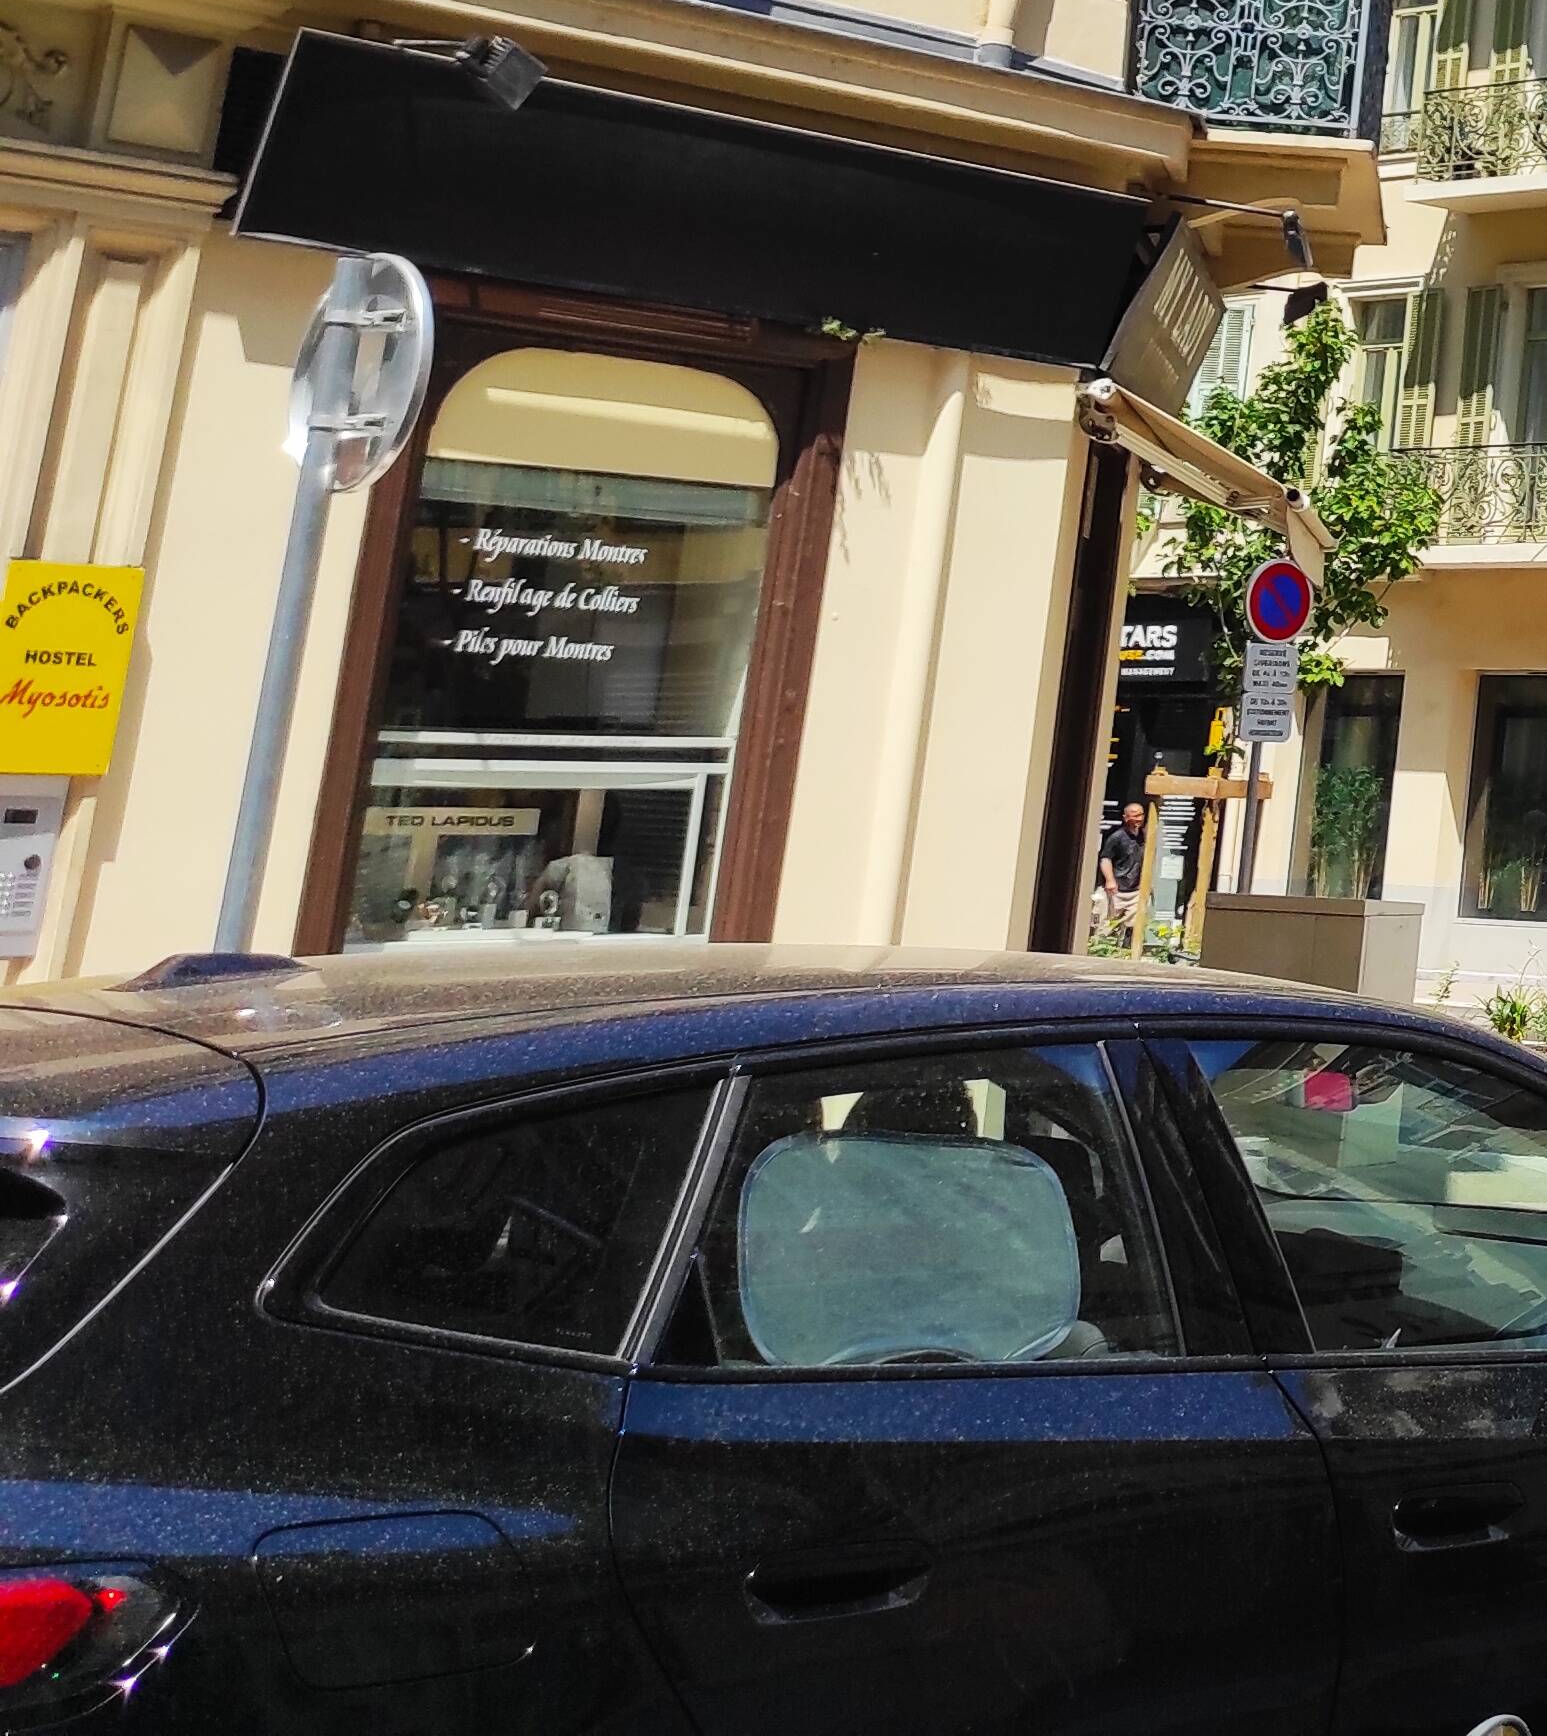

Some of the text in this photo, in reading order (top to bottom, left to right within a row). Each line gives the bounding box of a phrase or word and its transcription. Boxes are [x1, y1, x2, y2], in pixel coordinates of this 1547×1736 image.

[472, 528, 649, 564] Réparations Montres
[5, 580, 130, 635] BACKPACKERS
[464, 577, 641, 617] Renfilage de Colliers
[25, 649, 97, 667] HOSTEL
[453, 626, 615, 665] Piles pour Montres
[0, 679, 110, 718] Myosotis
[386, 815, 515, 827] TED LAPIDUS
